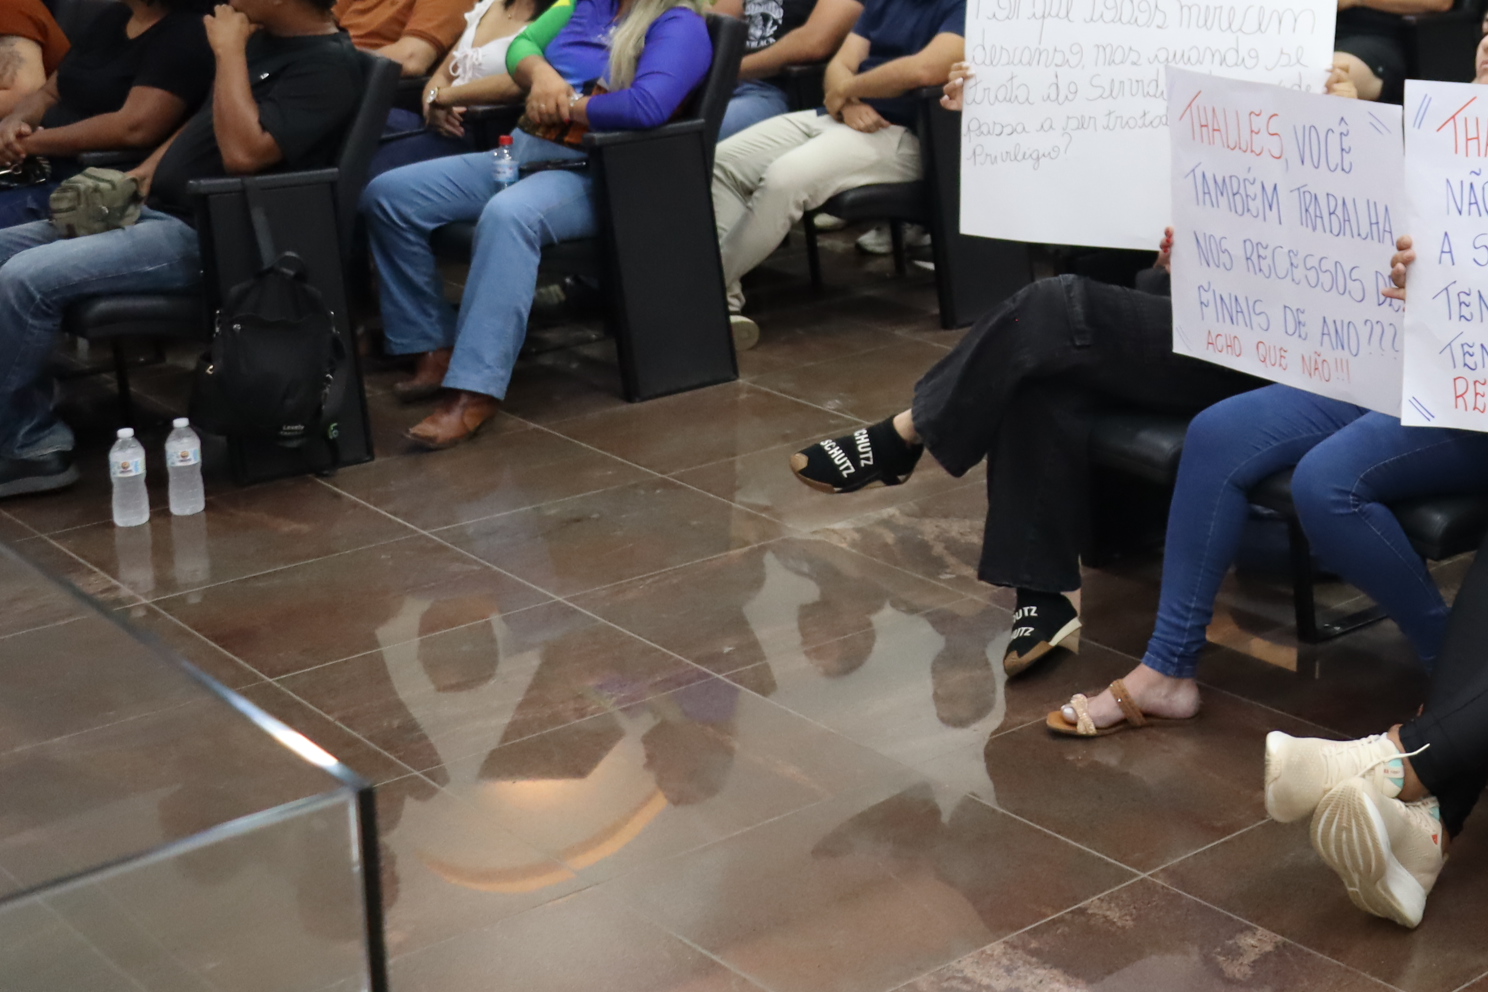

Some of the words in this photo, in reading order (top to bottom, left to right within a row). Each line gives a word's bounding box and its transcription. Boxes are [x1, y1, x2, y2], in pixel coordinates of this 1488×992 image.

[1094, 43, 1143, 67] mas
[1147, 36, 1261, 70] quando
[1265, 44, 1309, 71] se
[964, 71, 1035, 107] trata
[1042, 71, 1078, 106] do
[1085, 68, 1168, 102] Servid
[964, 117, 1031, 143] passa
[1036, 117, 1055, 134] a
[1062, 113, 1098, 133] ser
[1102, 106, 1168, 132] tratad
[1179, 90, 1289, 172] THALLES,
[1293, 116, 1353, 174] VOCÊ
[1184, 162, 1282, 226] TAMBÉM
[1290, 184, 1395, 247] TRABALHA
[1193, 230, 1234, 272] NOS
[1243, 238, 1366, 304] RECESSOS
[1438, 231, 1456, 267] A
[1198, 281, 1271, 332] FINAIS
[1283, 304, 1308, 341] DE
[1320, 316, 1399, 360] ANO???
[1207, 329, 1242, 358] ACHO
[1256, 340, 1288, 371] QUE
[1301, 352, 1352, 385] NÃO!!!
[820, 439, 856, 478] SCHUTZ
[853, 428, 874, 467] CHUTZ
[1010, 626, 1035, 639] UTZ
[1013, 605, 1038, 623] UTZ
